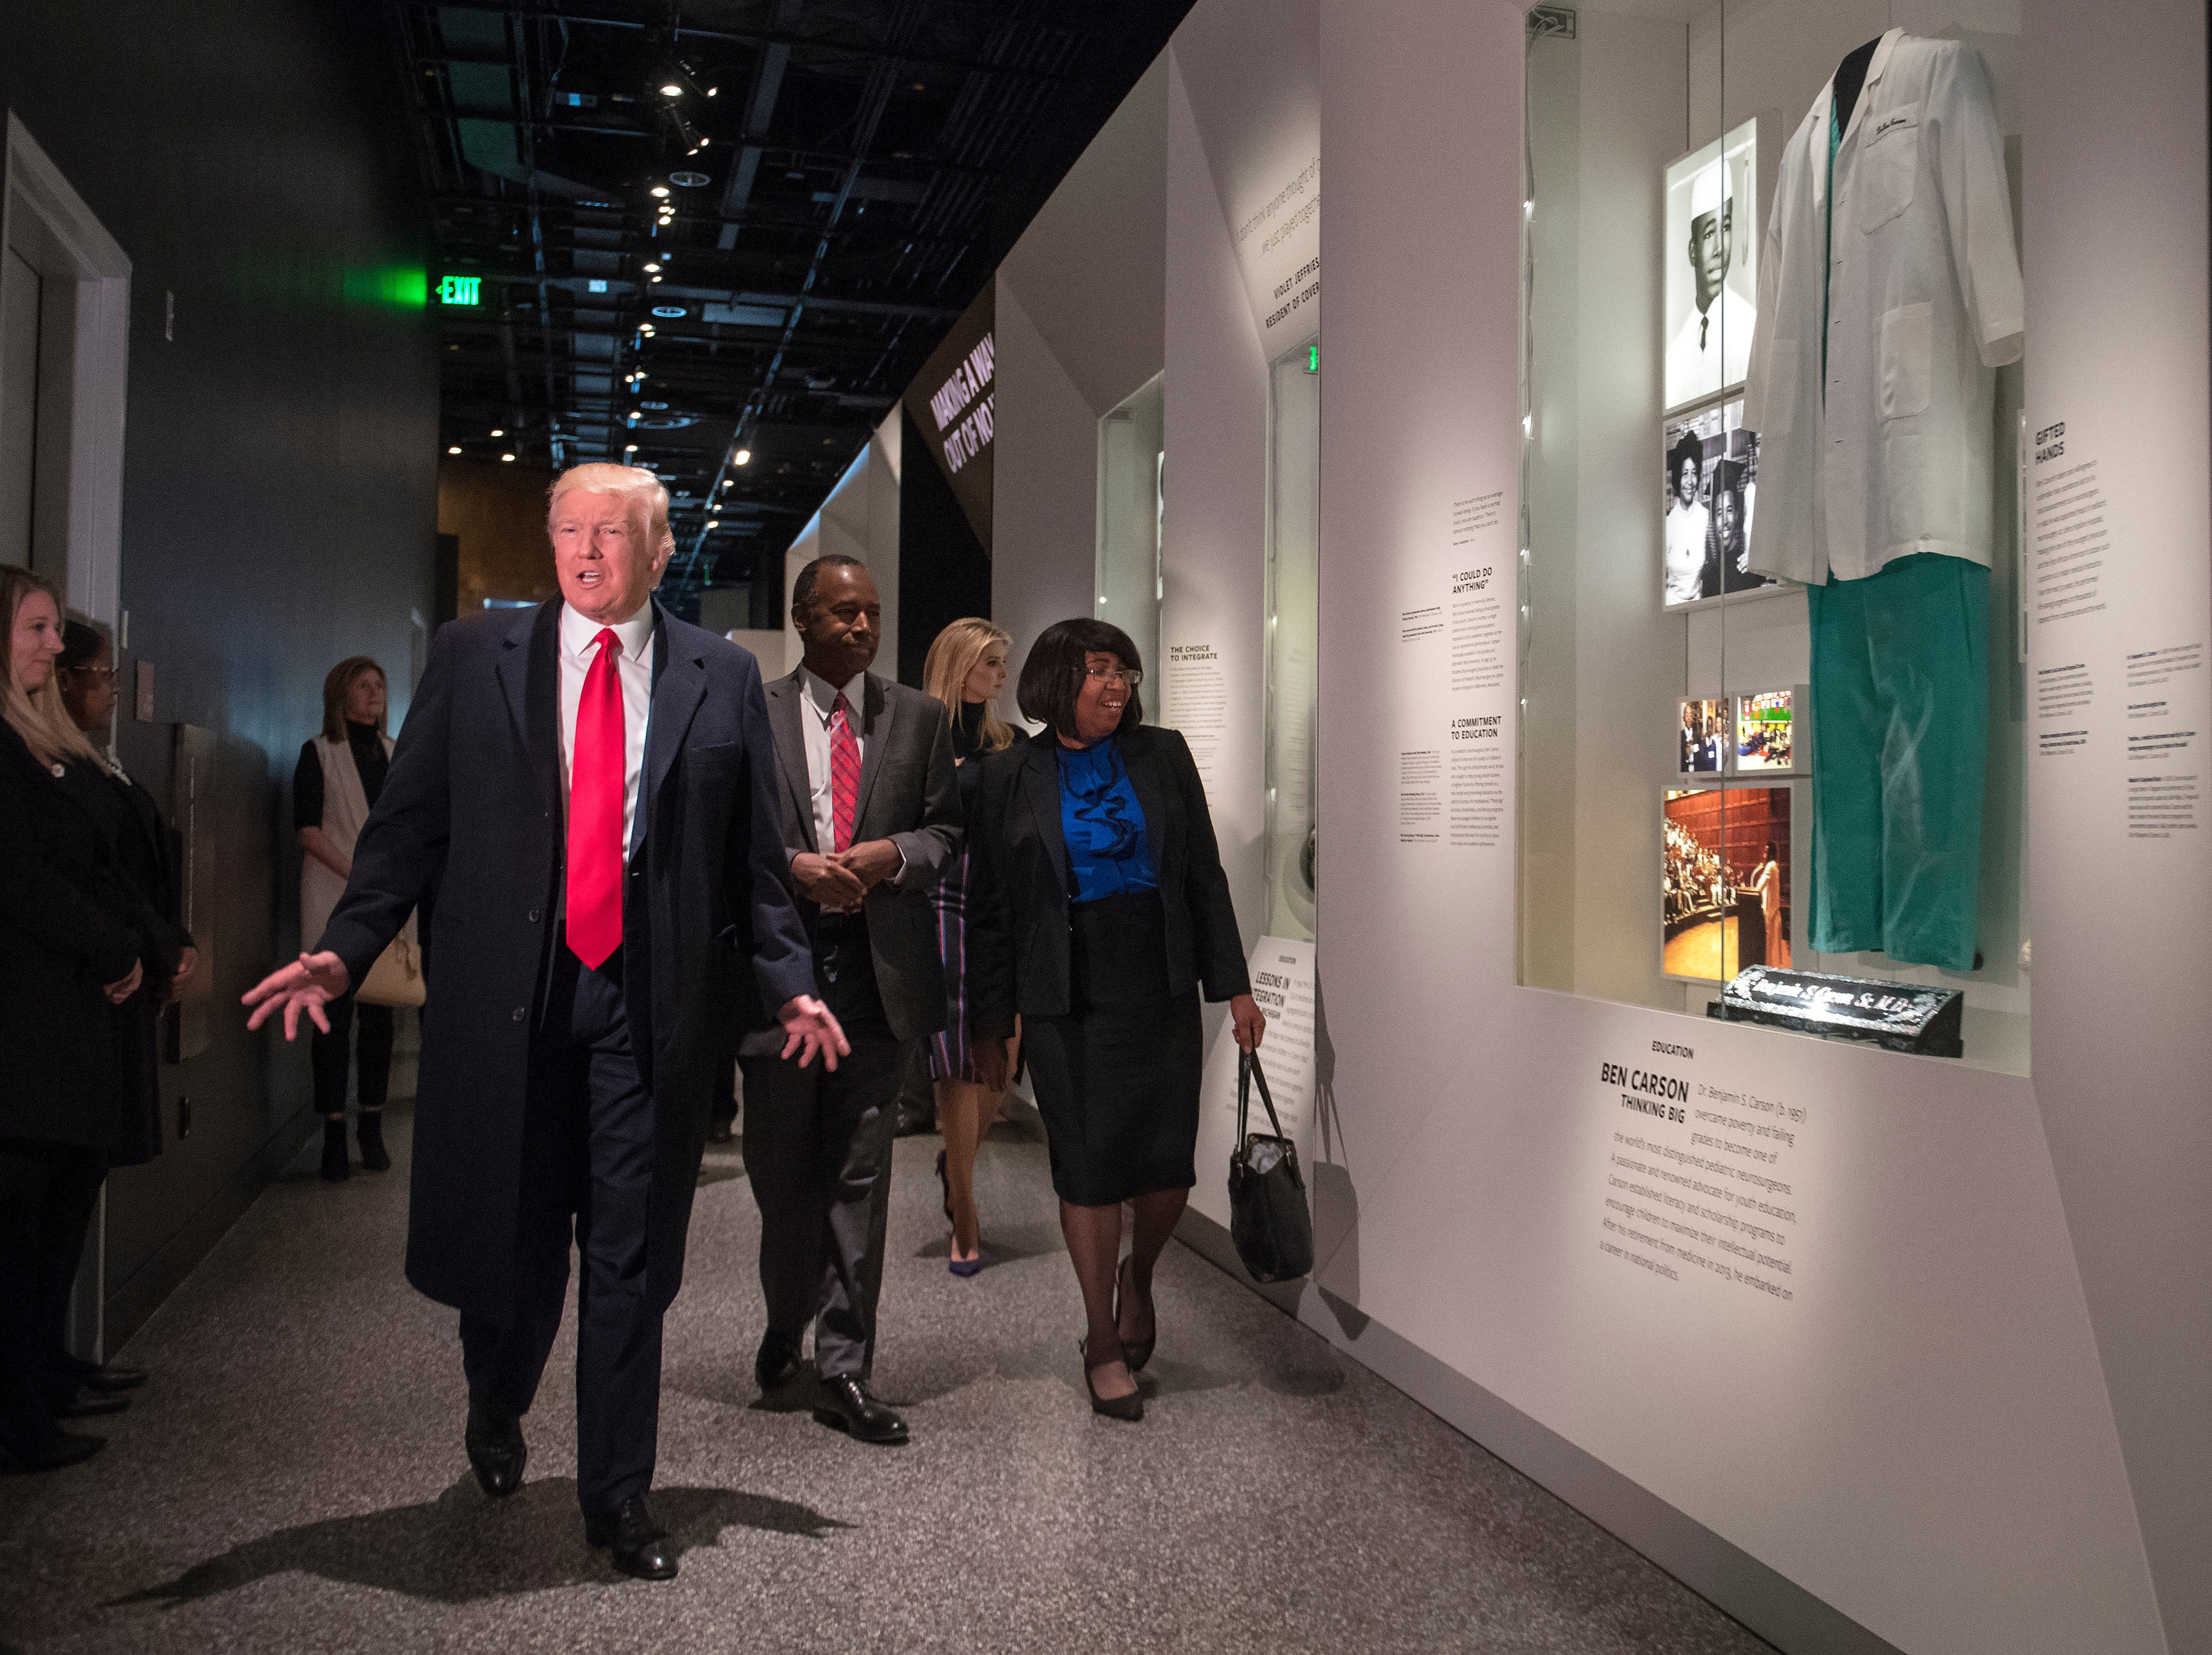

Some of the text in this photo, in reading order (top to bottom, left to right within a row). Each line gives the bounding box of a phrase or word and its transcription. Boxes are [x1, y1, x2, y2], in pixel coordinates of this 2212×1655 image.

[442, 276, 482, 305] EXIT
[1273, 257, 1319, 299] VIOLET JEFFRIES
[1266, 303, 1291, 329] RESIDENT
[1292, 296, 1300, 309] OF
[930, 367, 971, 432] MAKING
[964, 359, 980, 398] A
[944, 429, 967, 473] OUT
[961, 416, 979, 457] OF
[1453, 579, 1489, 594] ANYTHING”
[1460, 569, 1481, 581] COULD
[1483, 567, 1492, 576] DO
[1452, 716, 1501, 728] A COMMITMENT
[1452, 728, 1498, 740] TO EDUCATION
[1256, 971, 1291, 990] LESSONS IN
[1652, 1040, 1694, 1059] EDUCATION
[1601, 1062, 1689, 1103] BEN CARSON
[1698, 1083, 1707, 1096] Dr.
[1708, 1086, 1740, 1105] Benjamin
[1740, 1094, 1747, 1106] S.
[1749, 1096, 1774, 1114] Carson
[1621, 1094, 1685, 1124] THINKING BIG
[1694, 1109, 1795, 1147] overcame poverty and failing
[1613, 1129, 1624, 1143] the
[1646, 1142, 1662, 1155] most
[1663, 1143, 1705, 1168] distinguished
[1705, 1158, 1735, 1178] pediatric
[1690, 1132, 1778, 1164] grades to become one of
[1611, 1151, 1615, 1163] A
[1647, 1165, 1660, 1177] and
[1660, 1170, 1692, 1188] renowned
[1692, 1178, 1723, 1199] advocate
[1723, 1187, 1734, 1202] for
[1734, 1195, 1756, 1210] youth
[1608, 1172, 1785, 1246] Carson established literacy and scholarship programs to
[1605, 1197, 1635, 1219] encourage
[1636, 1206, 1661, 1226] children
[1661, 1216, 1668, 1228] to
[1717, 1237, 1756, 1261] intellectual
[1604, 1242, 1624, 1258] career
[1660, 1237, 1676, 1255] from
[1676, 1246, 1706, 1268] medicine
[1733, 1266, 1744, 1282] he
[1744, 1274, 1781, 1297] embarked
[1782, 1289, 1793, 1302] on
